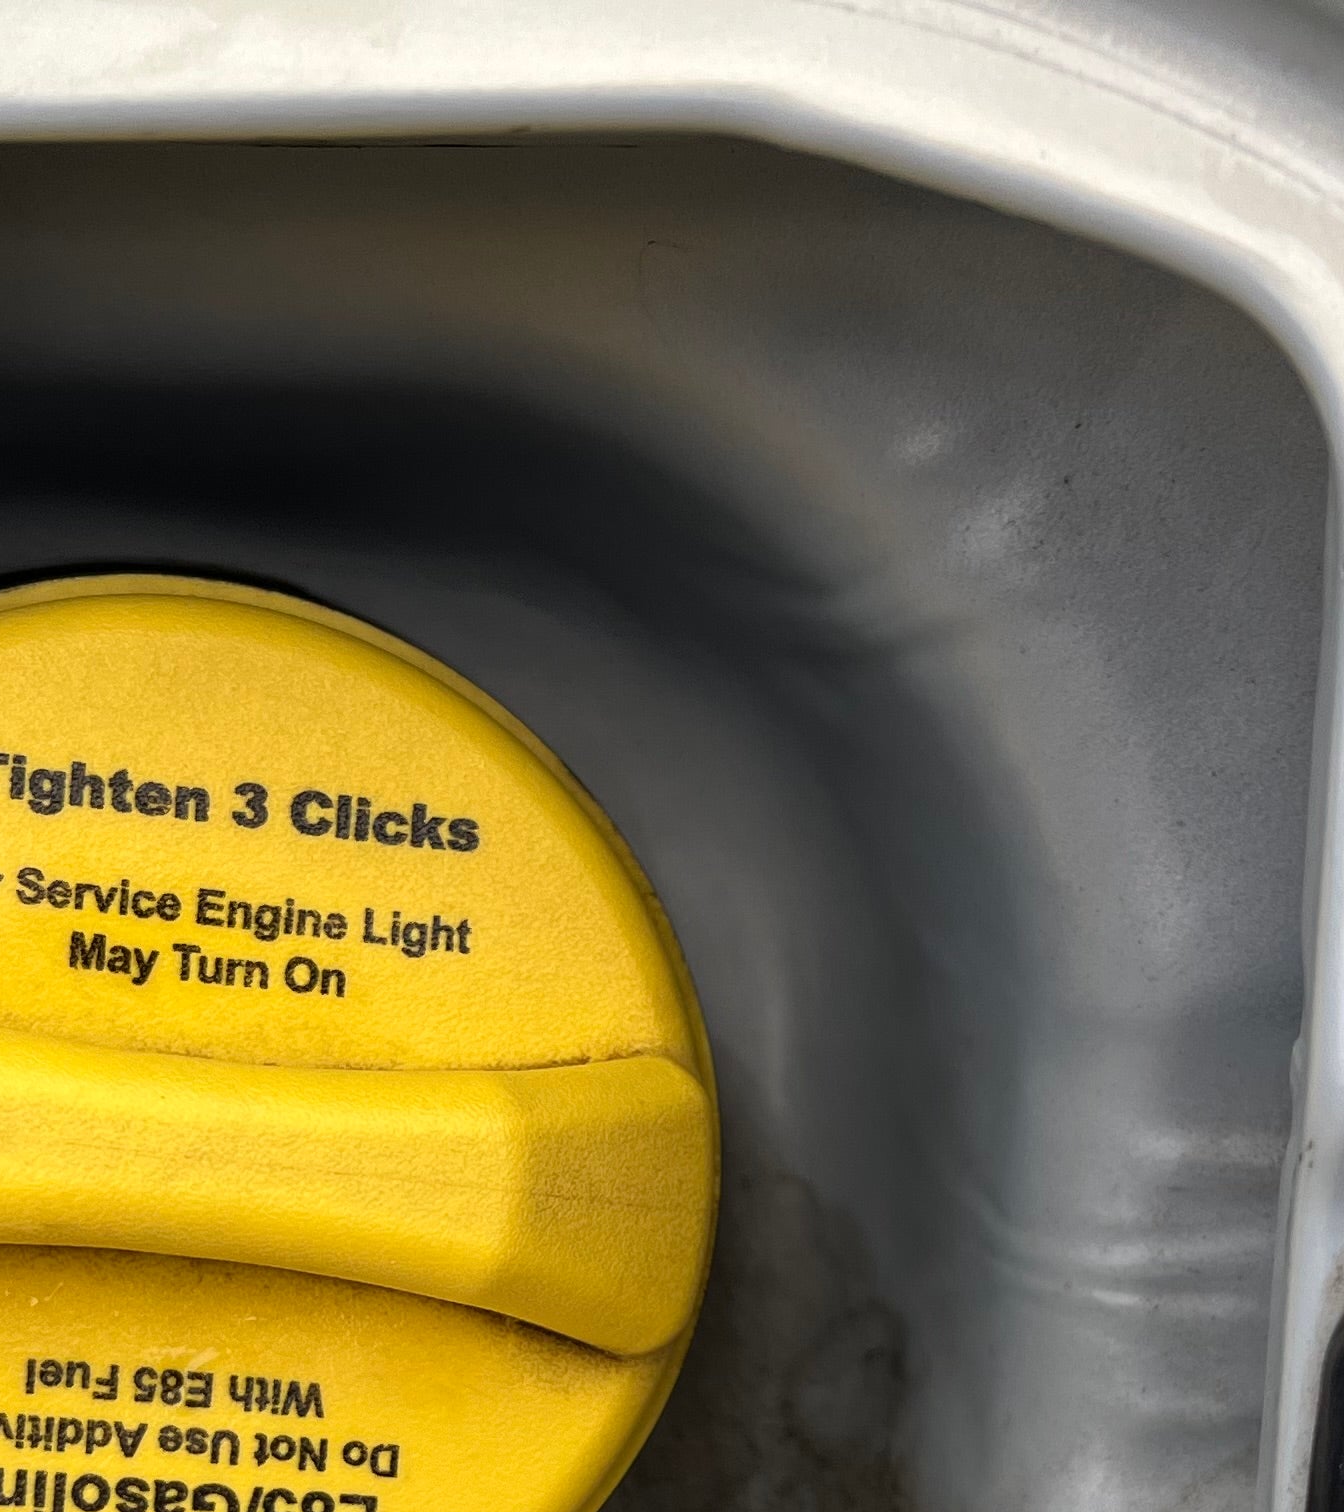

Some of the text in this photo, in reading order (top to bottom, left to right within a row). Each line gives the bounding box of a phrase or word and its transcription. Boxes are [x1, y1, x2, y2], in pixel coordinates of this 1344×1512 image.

[231, 782, 269, 829] 3
[290, 790, 480, 853] Clicks
[15, 867, 181, 922] Service
[195, 887, 348, 941] Engine
[362, 907, 471, 958] Light
[69, 931, 346, 998] May Turn On
[25, 1359, 324, 1419] With E85 Fuel
[157, 1425, 240, 1466] Use
[253, 1433, 328, 1472] Not
[342, 1440, 400, 1478] Do
